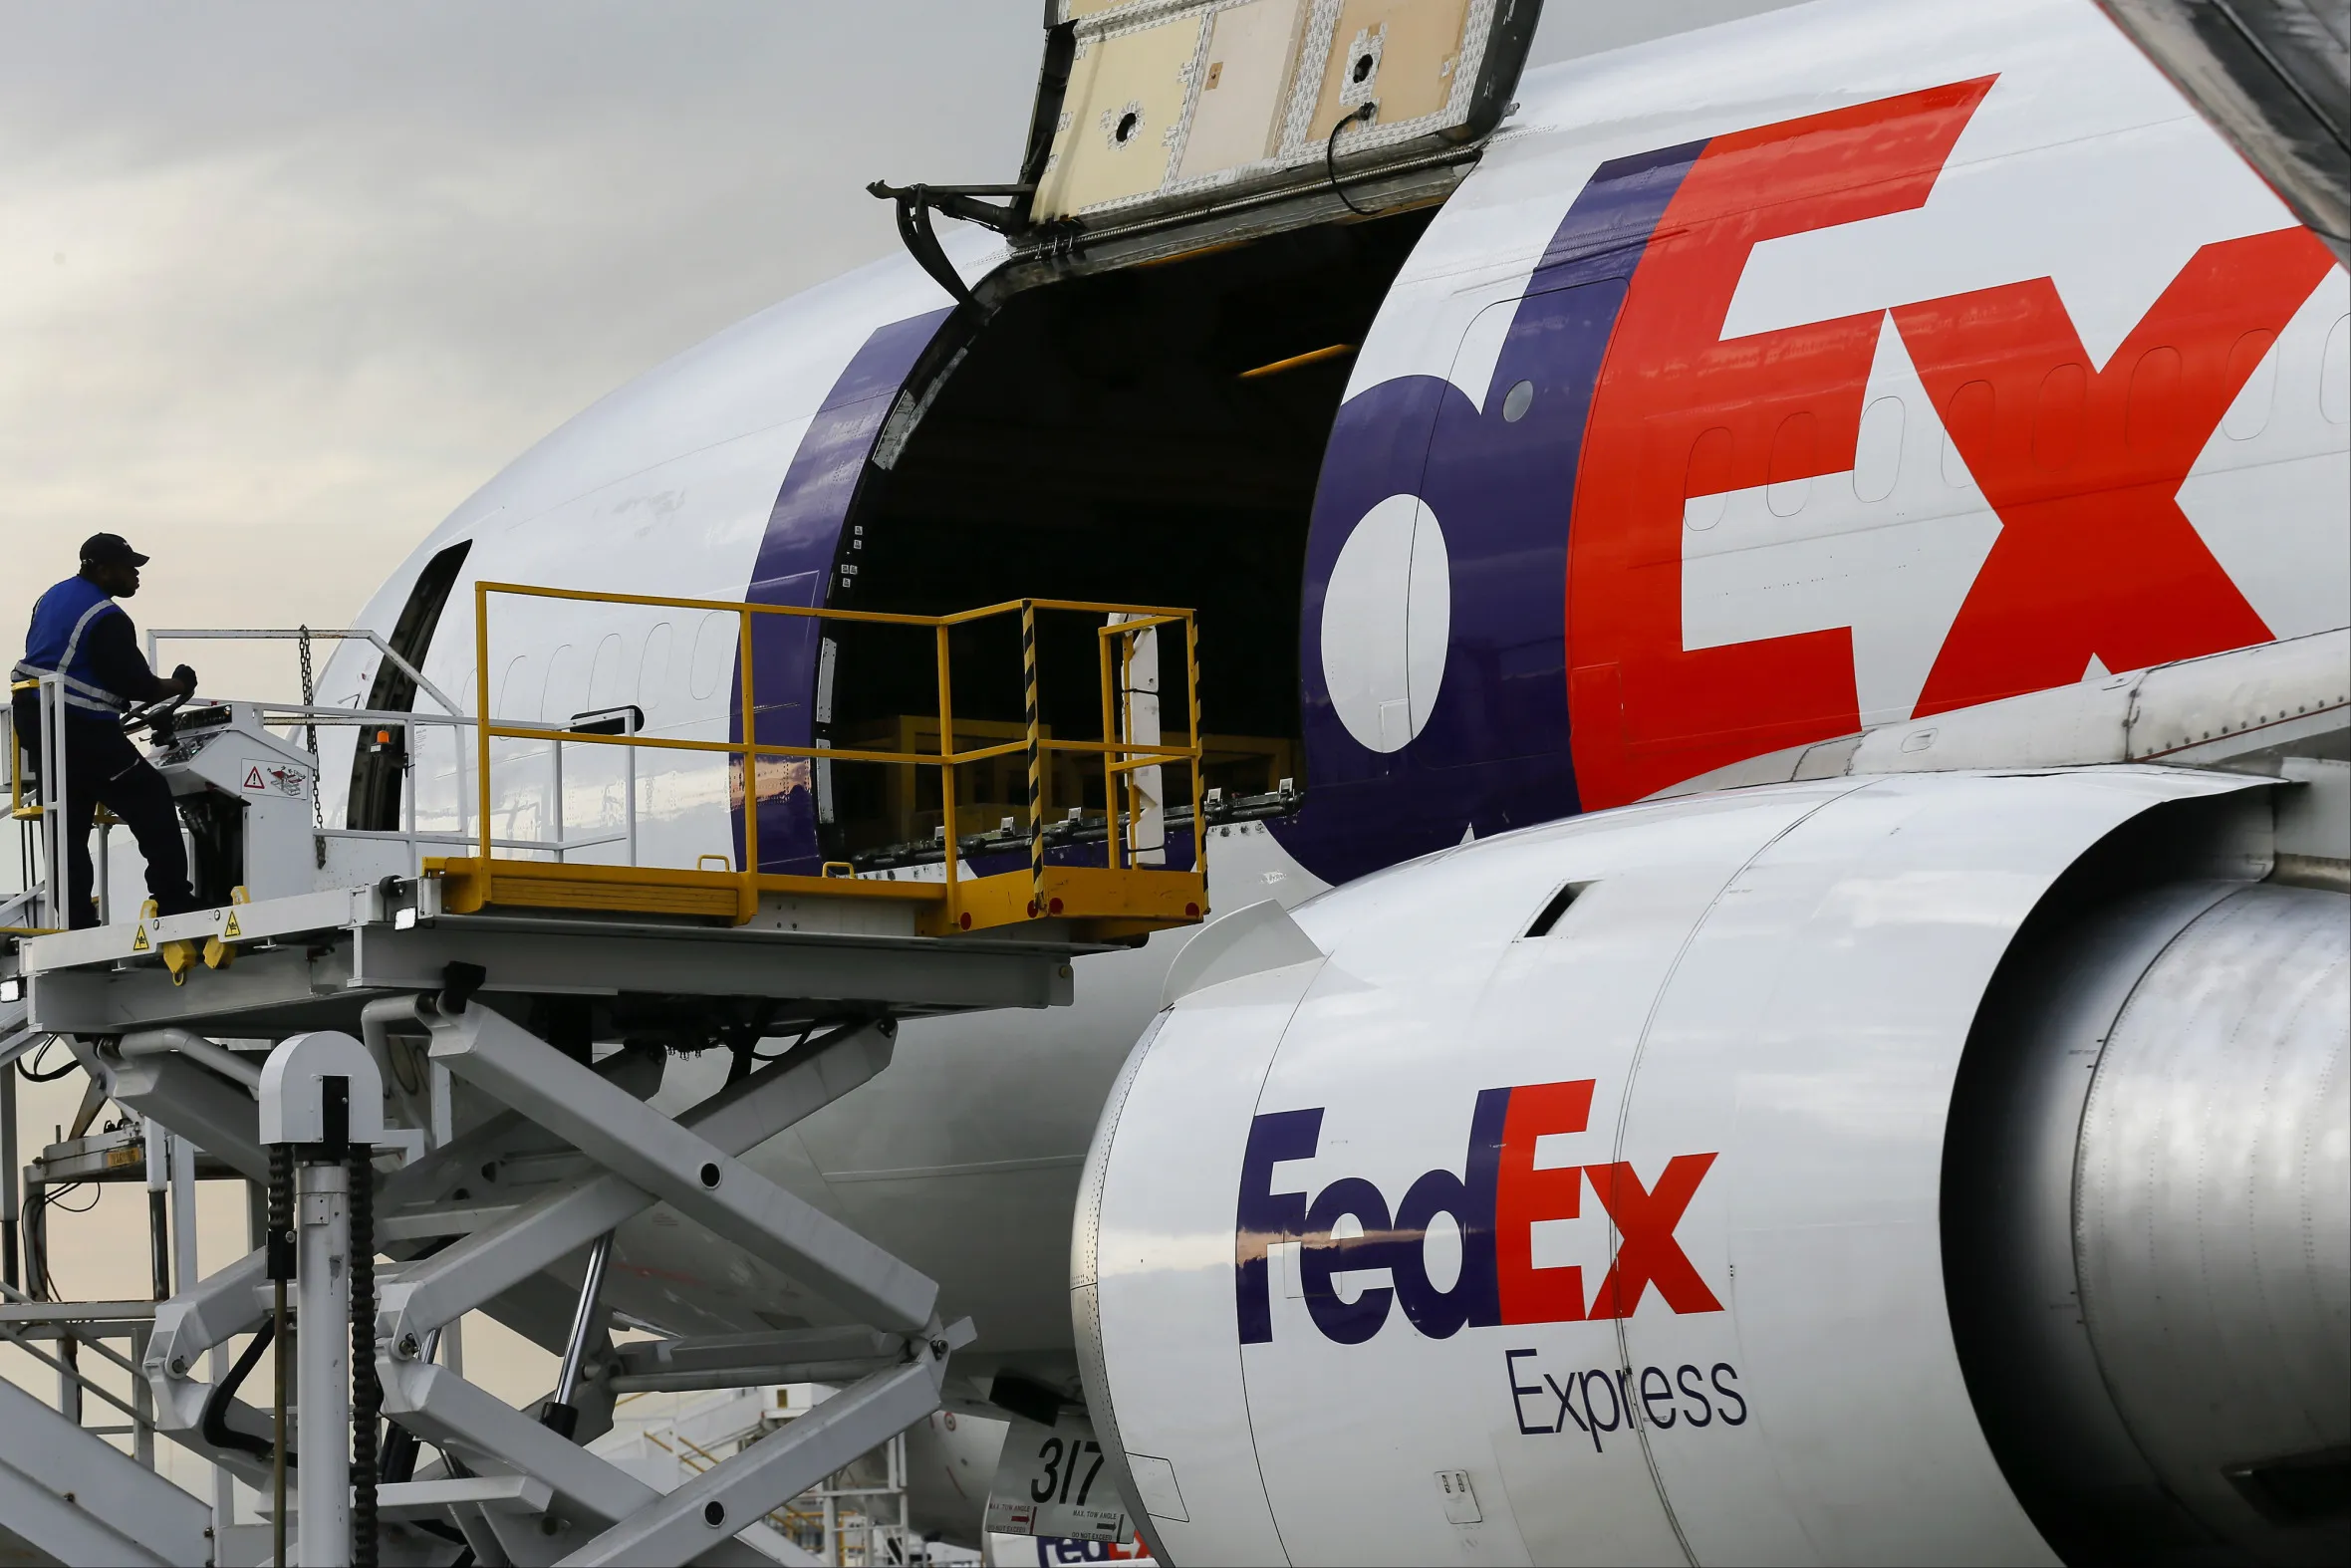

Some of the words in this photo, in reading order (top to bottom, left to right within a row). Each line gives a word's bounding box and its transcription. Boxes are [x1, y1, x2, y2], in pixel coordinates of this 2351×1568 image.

[1235, 1079, 1724, 1345] FedEx
[1505, 1348, 1748, 1452] Express
[1030, 1437, 1105, 1506] 317
